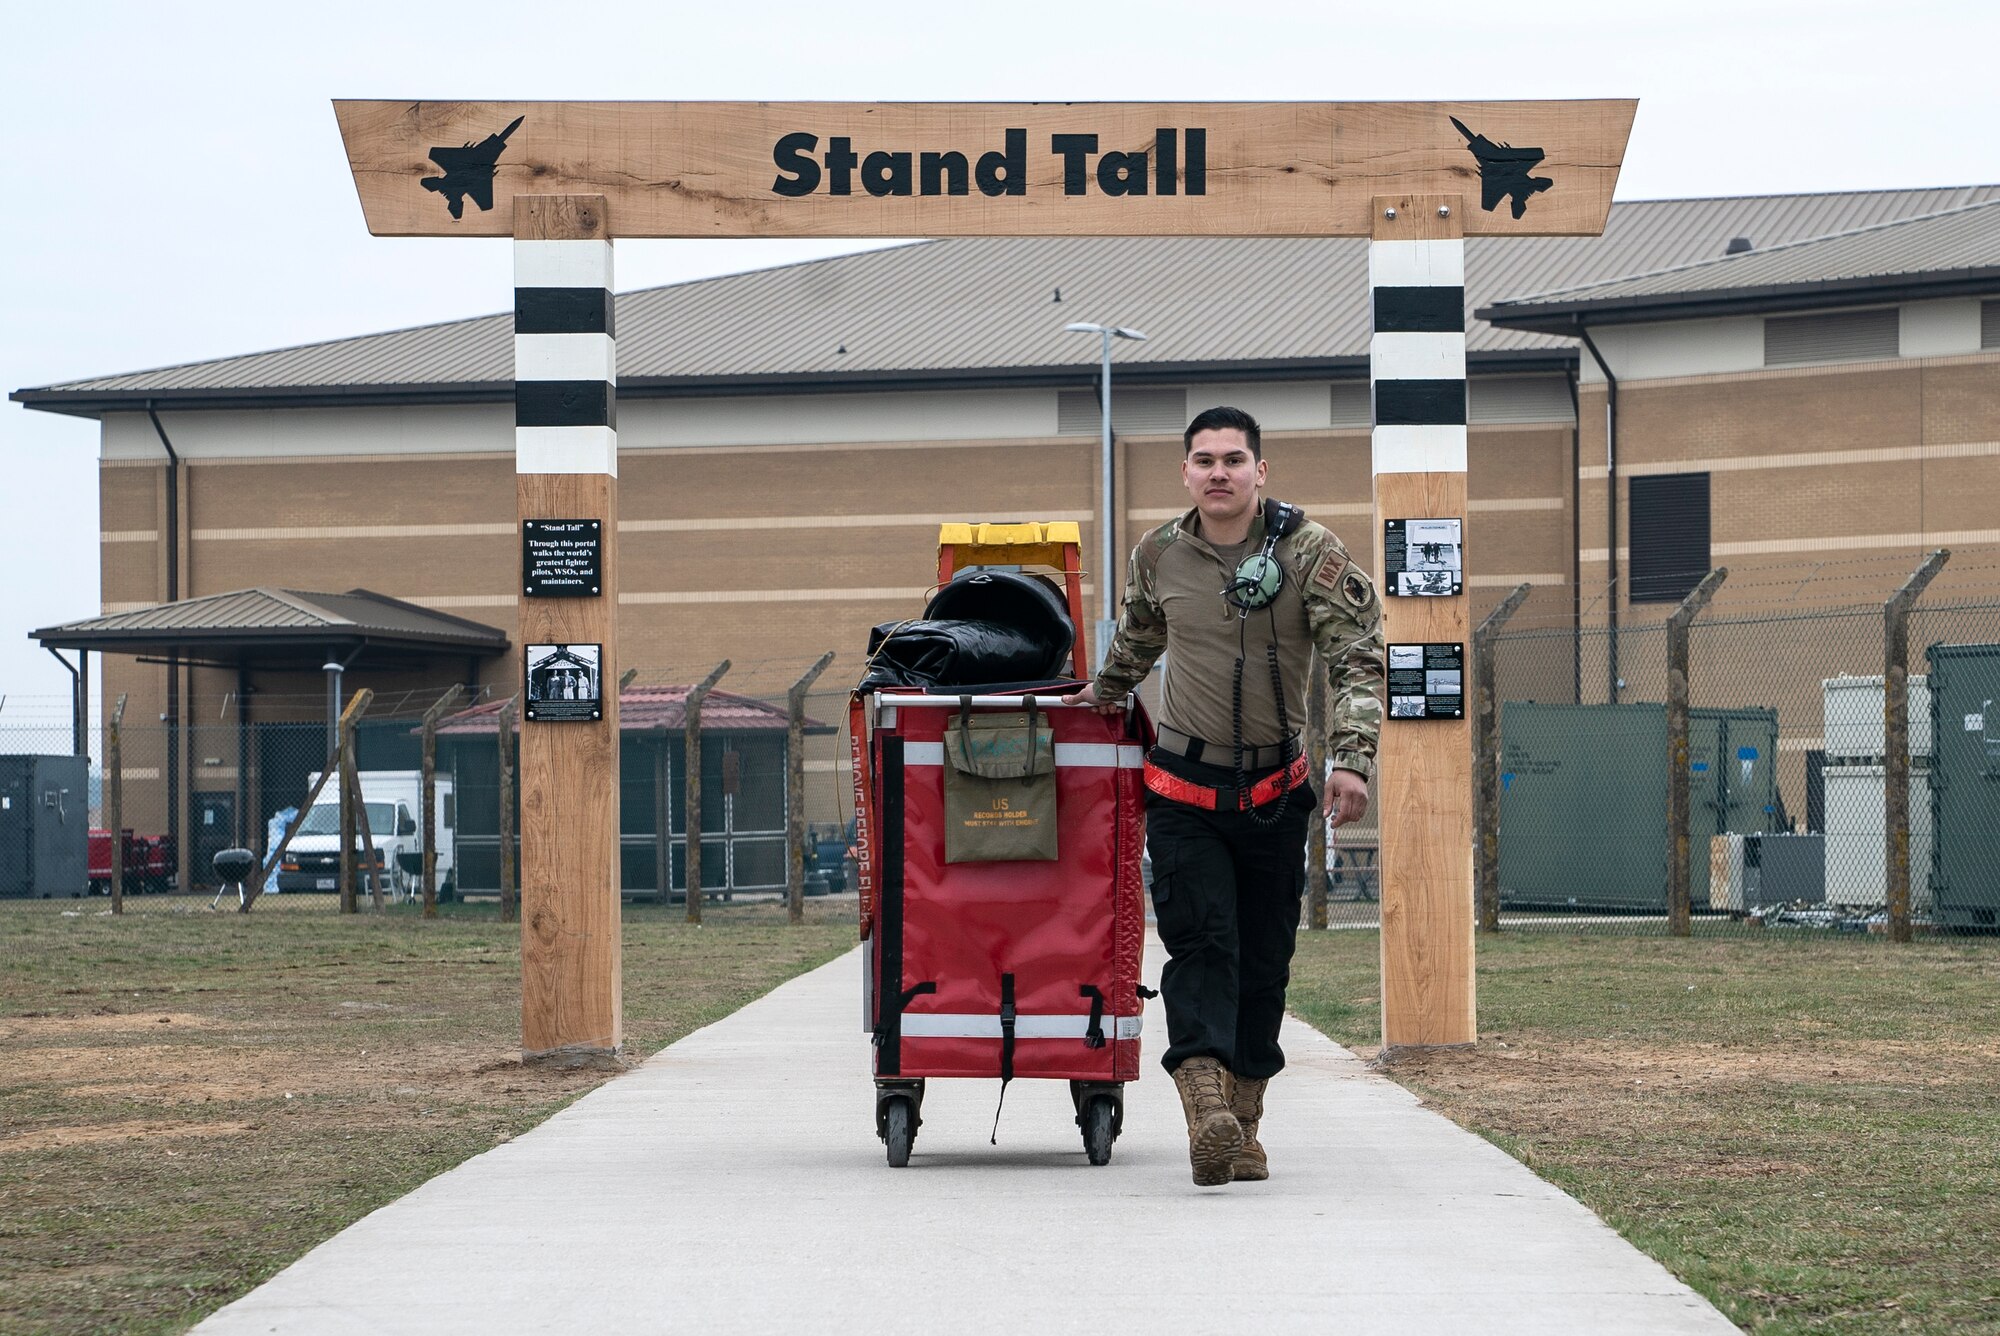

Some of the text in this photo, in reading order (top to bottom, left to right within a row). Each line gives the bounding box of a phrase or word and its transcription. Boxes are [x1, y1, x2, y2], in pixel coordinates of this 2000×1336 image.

[771, 128, 1206, 197] Stand Tall
[528, 540, 559, 548] Through
[574, 540, 596, 548] portal
[532, 568, 553, 577] pilots,
[565, 559, 589, 567] fighter
[1318, 556, 1343, 583] MX
[851, 735, 865, 802] REMOVE
[992, 798, 1009, 810] US
[855, 807, 871, 871] BEFORE
